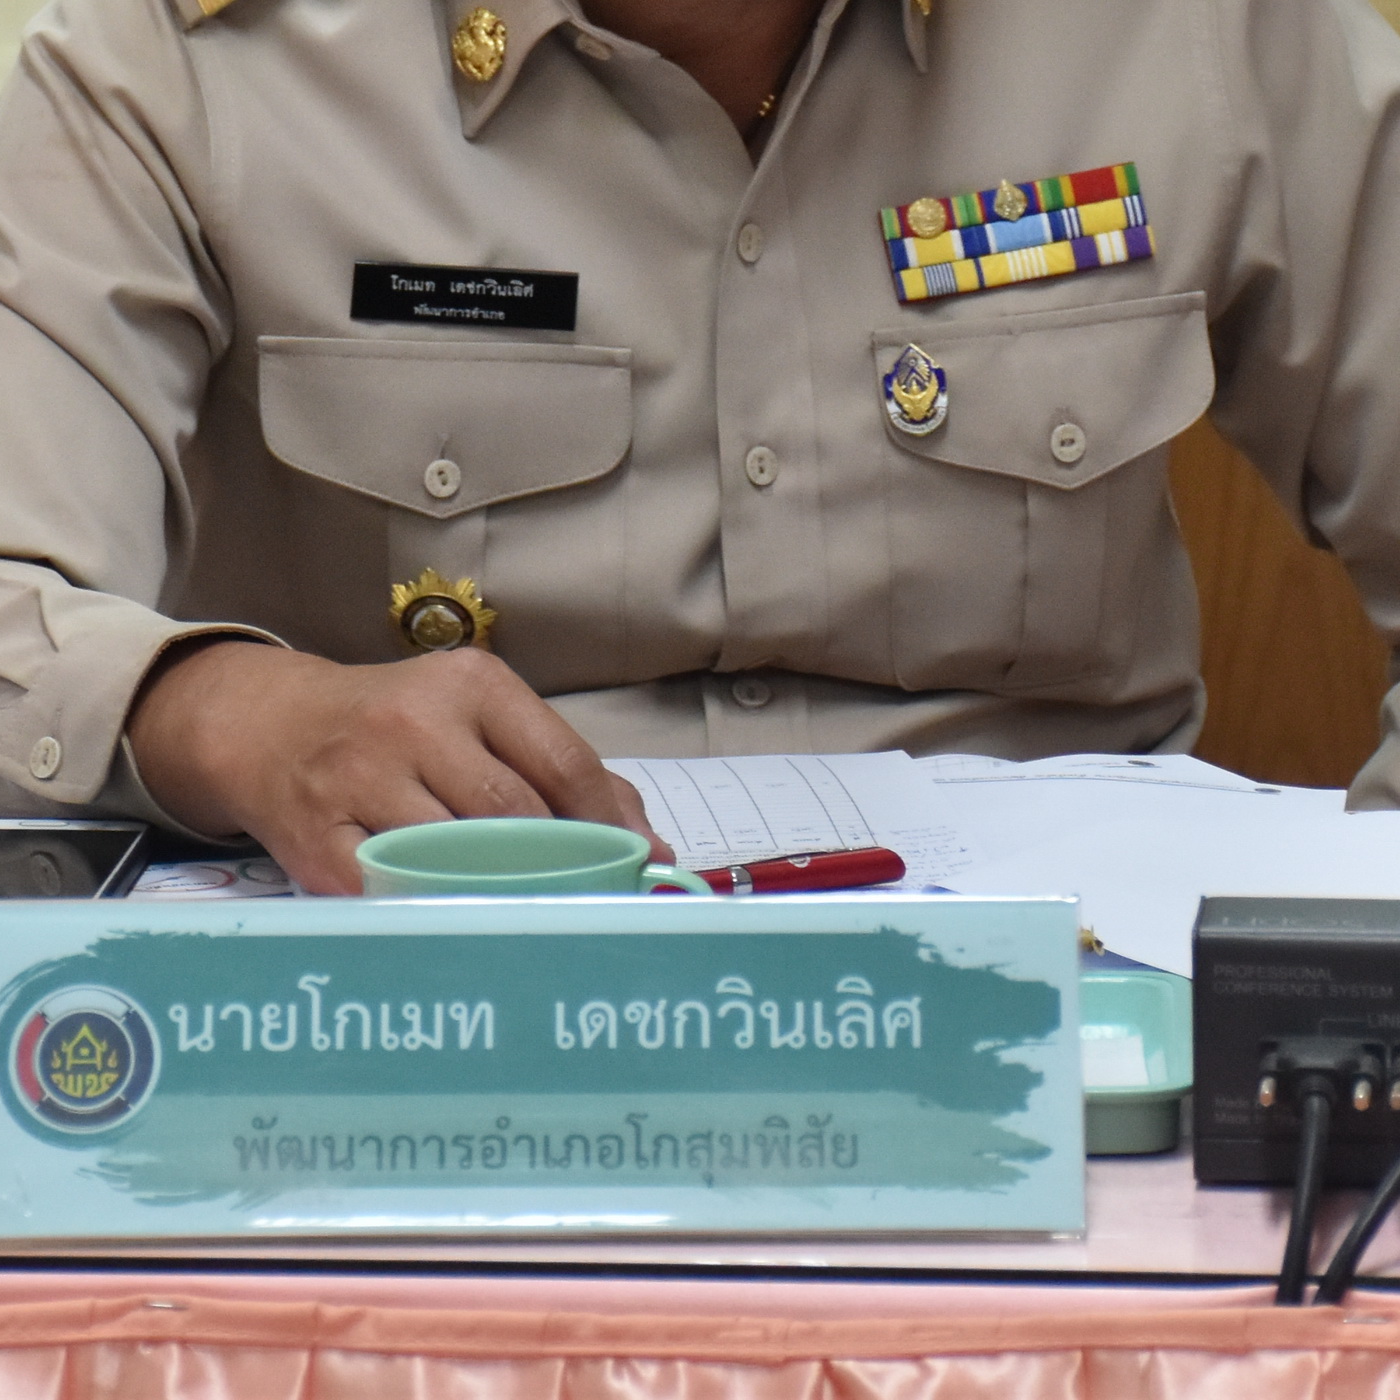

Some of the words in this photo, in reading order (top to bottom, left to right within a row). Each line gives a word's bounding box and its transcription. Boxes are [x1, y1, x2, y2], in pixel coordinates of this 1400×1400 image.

[167, 974, 496, 1055] นายโกเมท
[553, 976, 925, 1055] เดชกวินเลิศ
[1328, 983, 1394, 999] SYSTEM
[232, 1112, 862, 1190] พัฒนาการอำเภอโกสุมพิสัย
